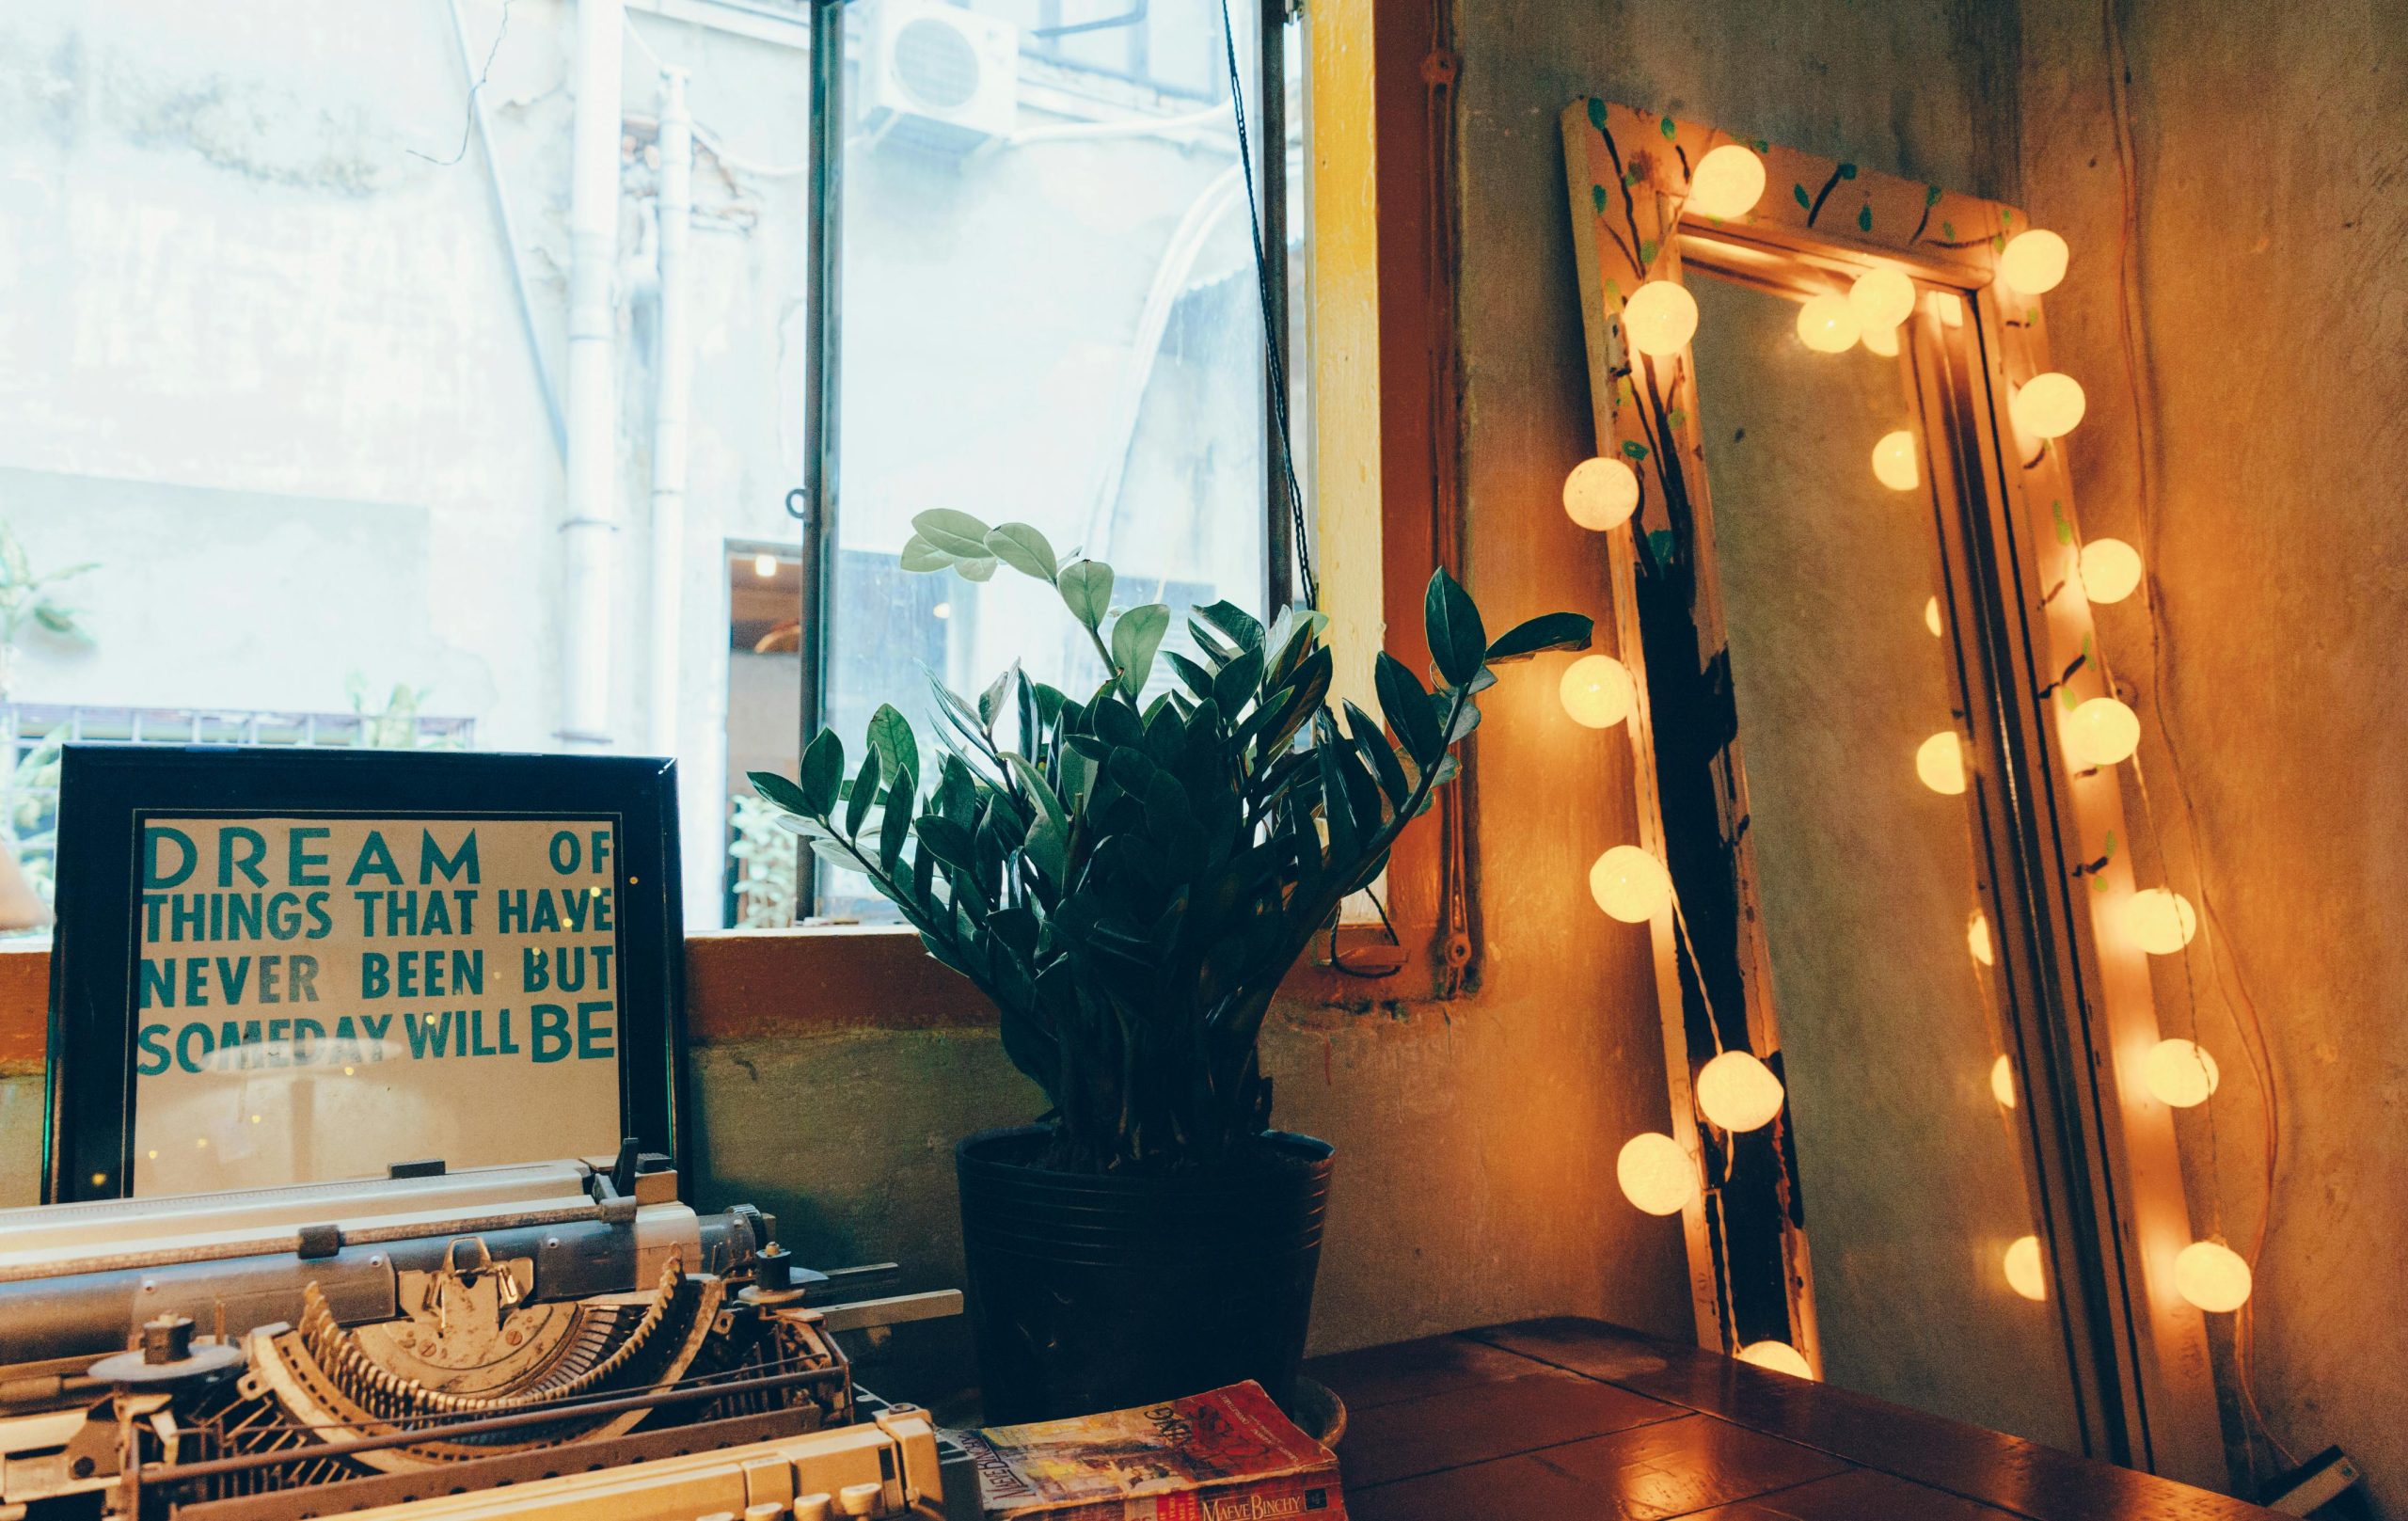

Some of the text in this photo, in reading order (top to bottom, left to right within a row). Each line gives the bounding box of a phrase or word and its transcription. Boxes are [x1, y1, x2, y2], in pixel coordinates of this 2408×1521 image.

[143, 827, 610, 890] DREAM OF
[142, 887, 613, 943] THINGS THAT HAVE
[139, 945, 613, 1009] NEVER BEEN BUT
[136, 1001, 615, 1076] SOMEDAY WILL BE
[1202, 1494, 1302, 1521] MAEVE BINCHY
